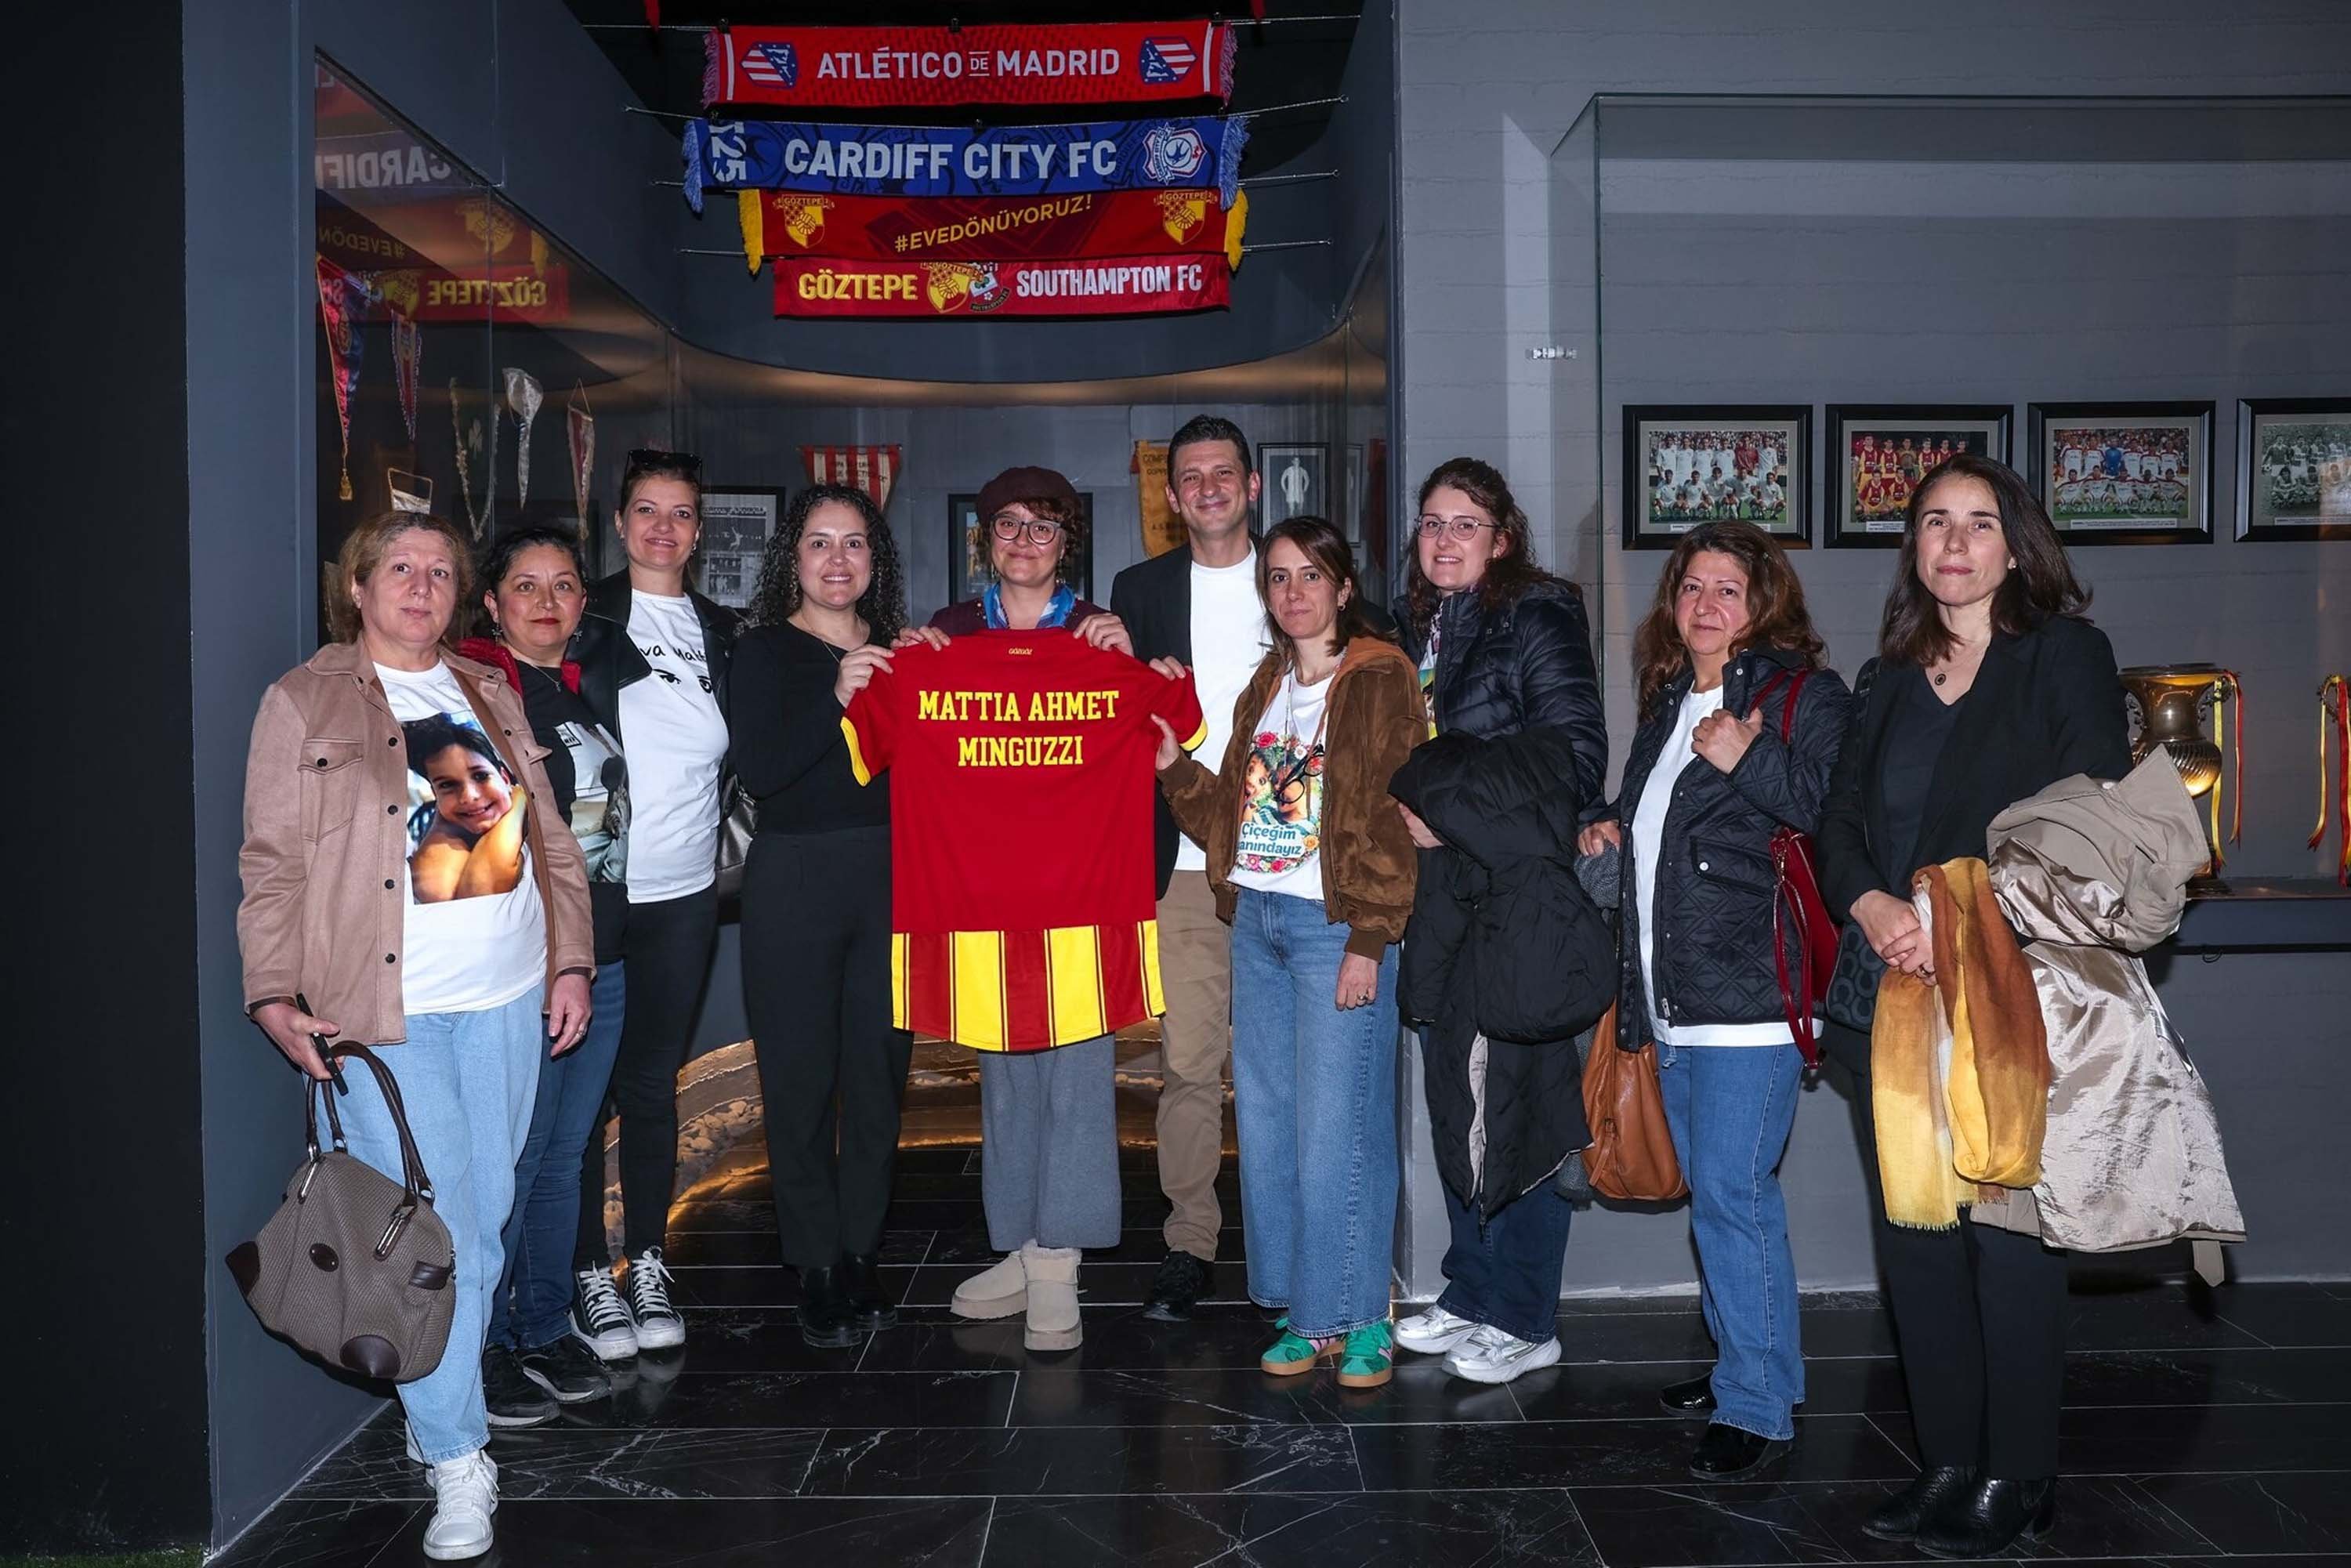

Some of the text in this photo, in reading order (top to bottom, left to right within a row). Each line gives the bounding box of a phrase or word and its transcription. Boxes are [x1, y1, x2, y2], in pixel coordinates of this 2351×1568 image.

[817, 47, 1120, 79] ATLÉTICO DE MADRID
[784, 139, 953, 179] CARDIFF
[964, 143, 1056, 179] CITY
[1069, 139, 1117, 178] FC
[894, 194, 1092, 252] #EVEDÖNÜYORUZ!
[799, 269, 918, 300] GÖZTEPE
[1016, 266, 1171, 297] SOUTHAMPTON
[1177, 264, 1202, 292] FC
[918, 690, 1120, 722] MATTIA AHMET
[958, 735, 1083, 767] MINGUZZI
[1241, 823, 1296, 841] Çiçeğim
[1238, 841, 1302, 856] anındayız
